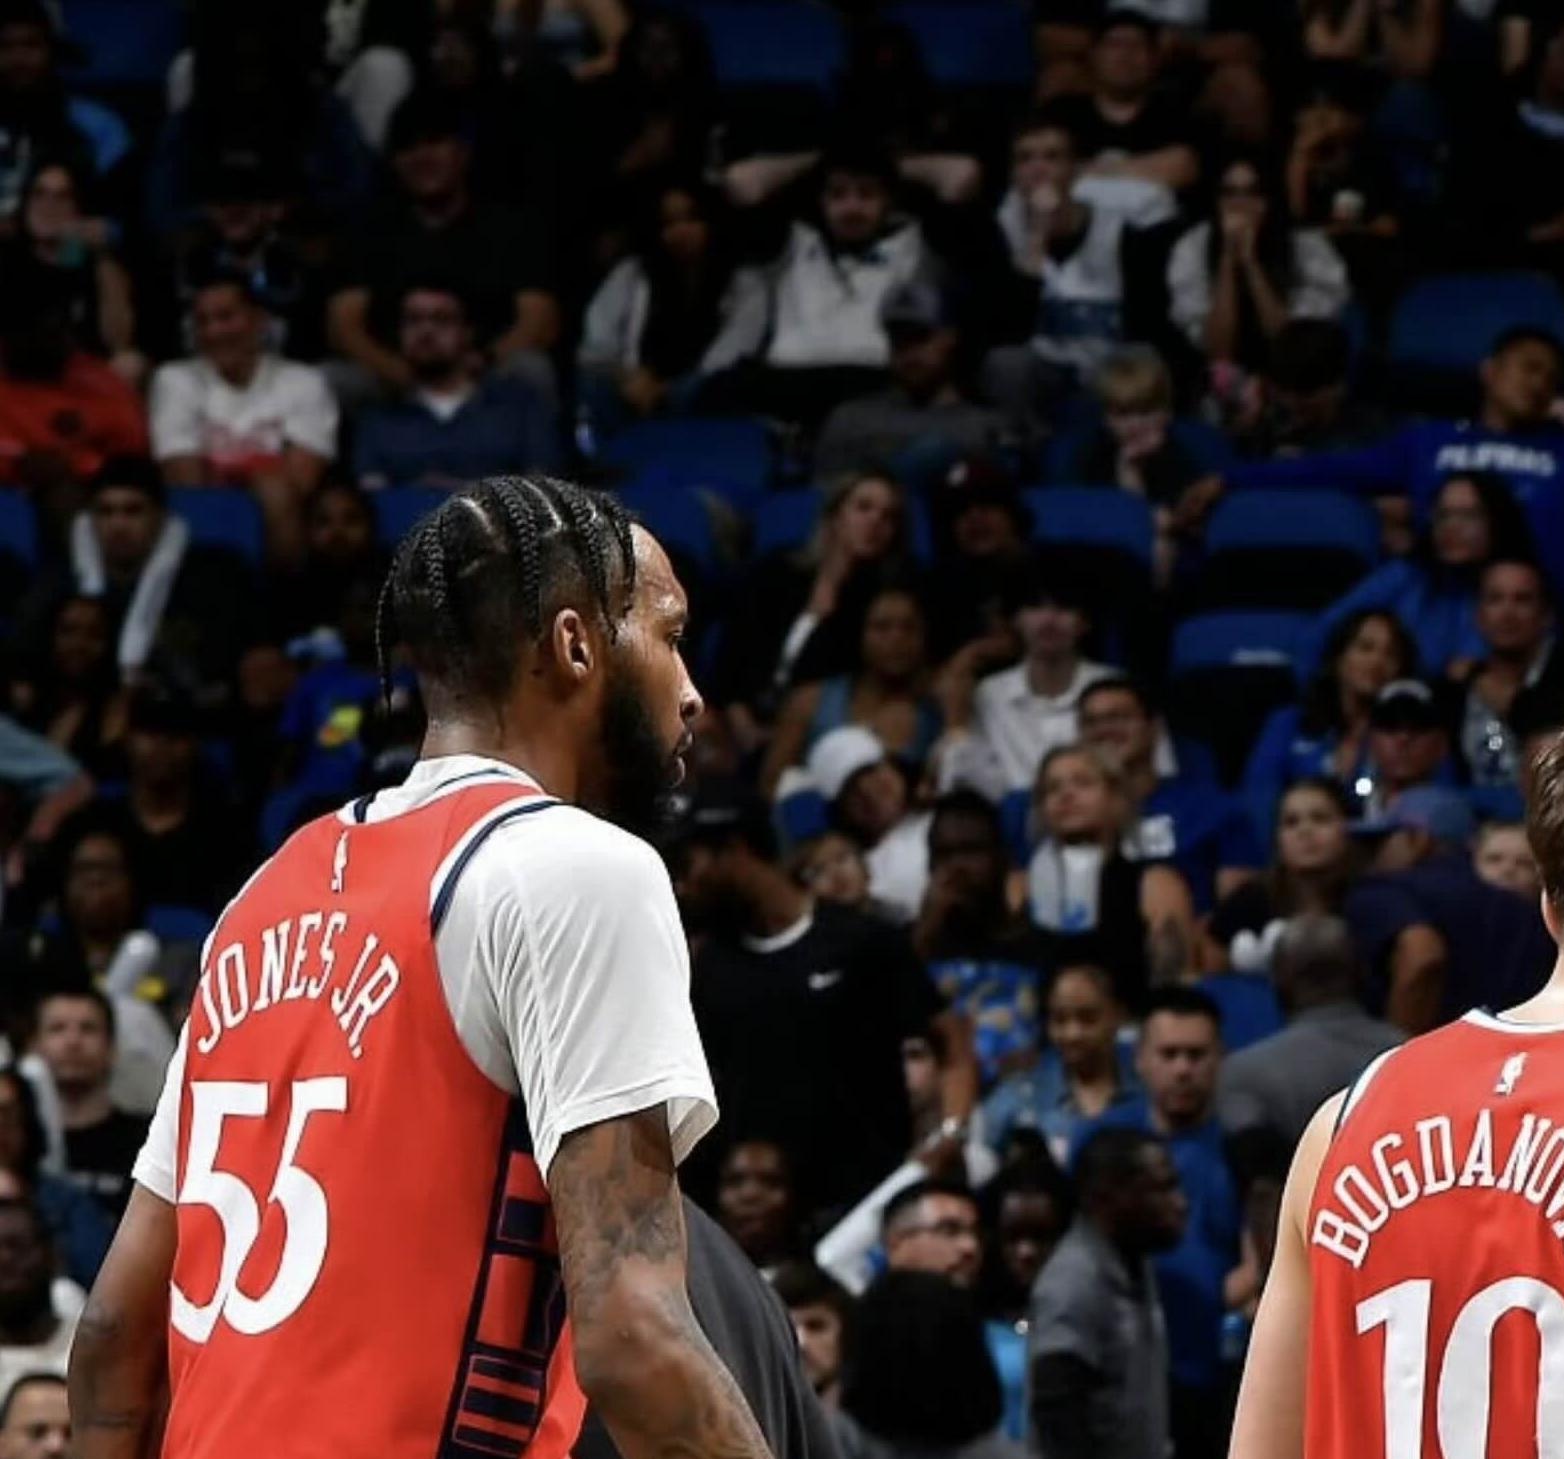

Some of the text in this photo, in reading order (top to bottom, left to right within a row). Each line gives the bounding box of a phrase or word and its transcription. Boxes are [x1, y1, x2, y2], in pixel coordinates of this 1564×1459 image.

[196, 910, 400, 1059] JONES JR.
[170, 1075, 348, 1344] 55
